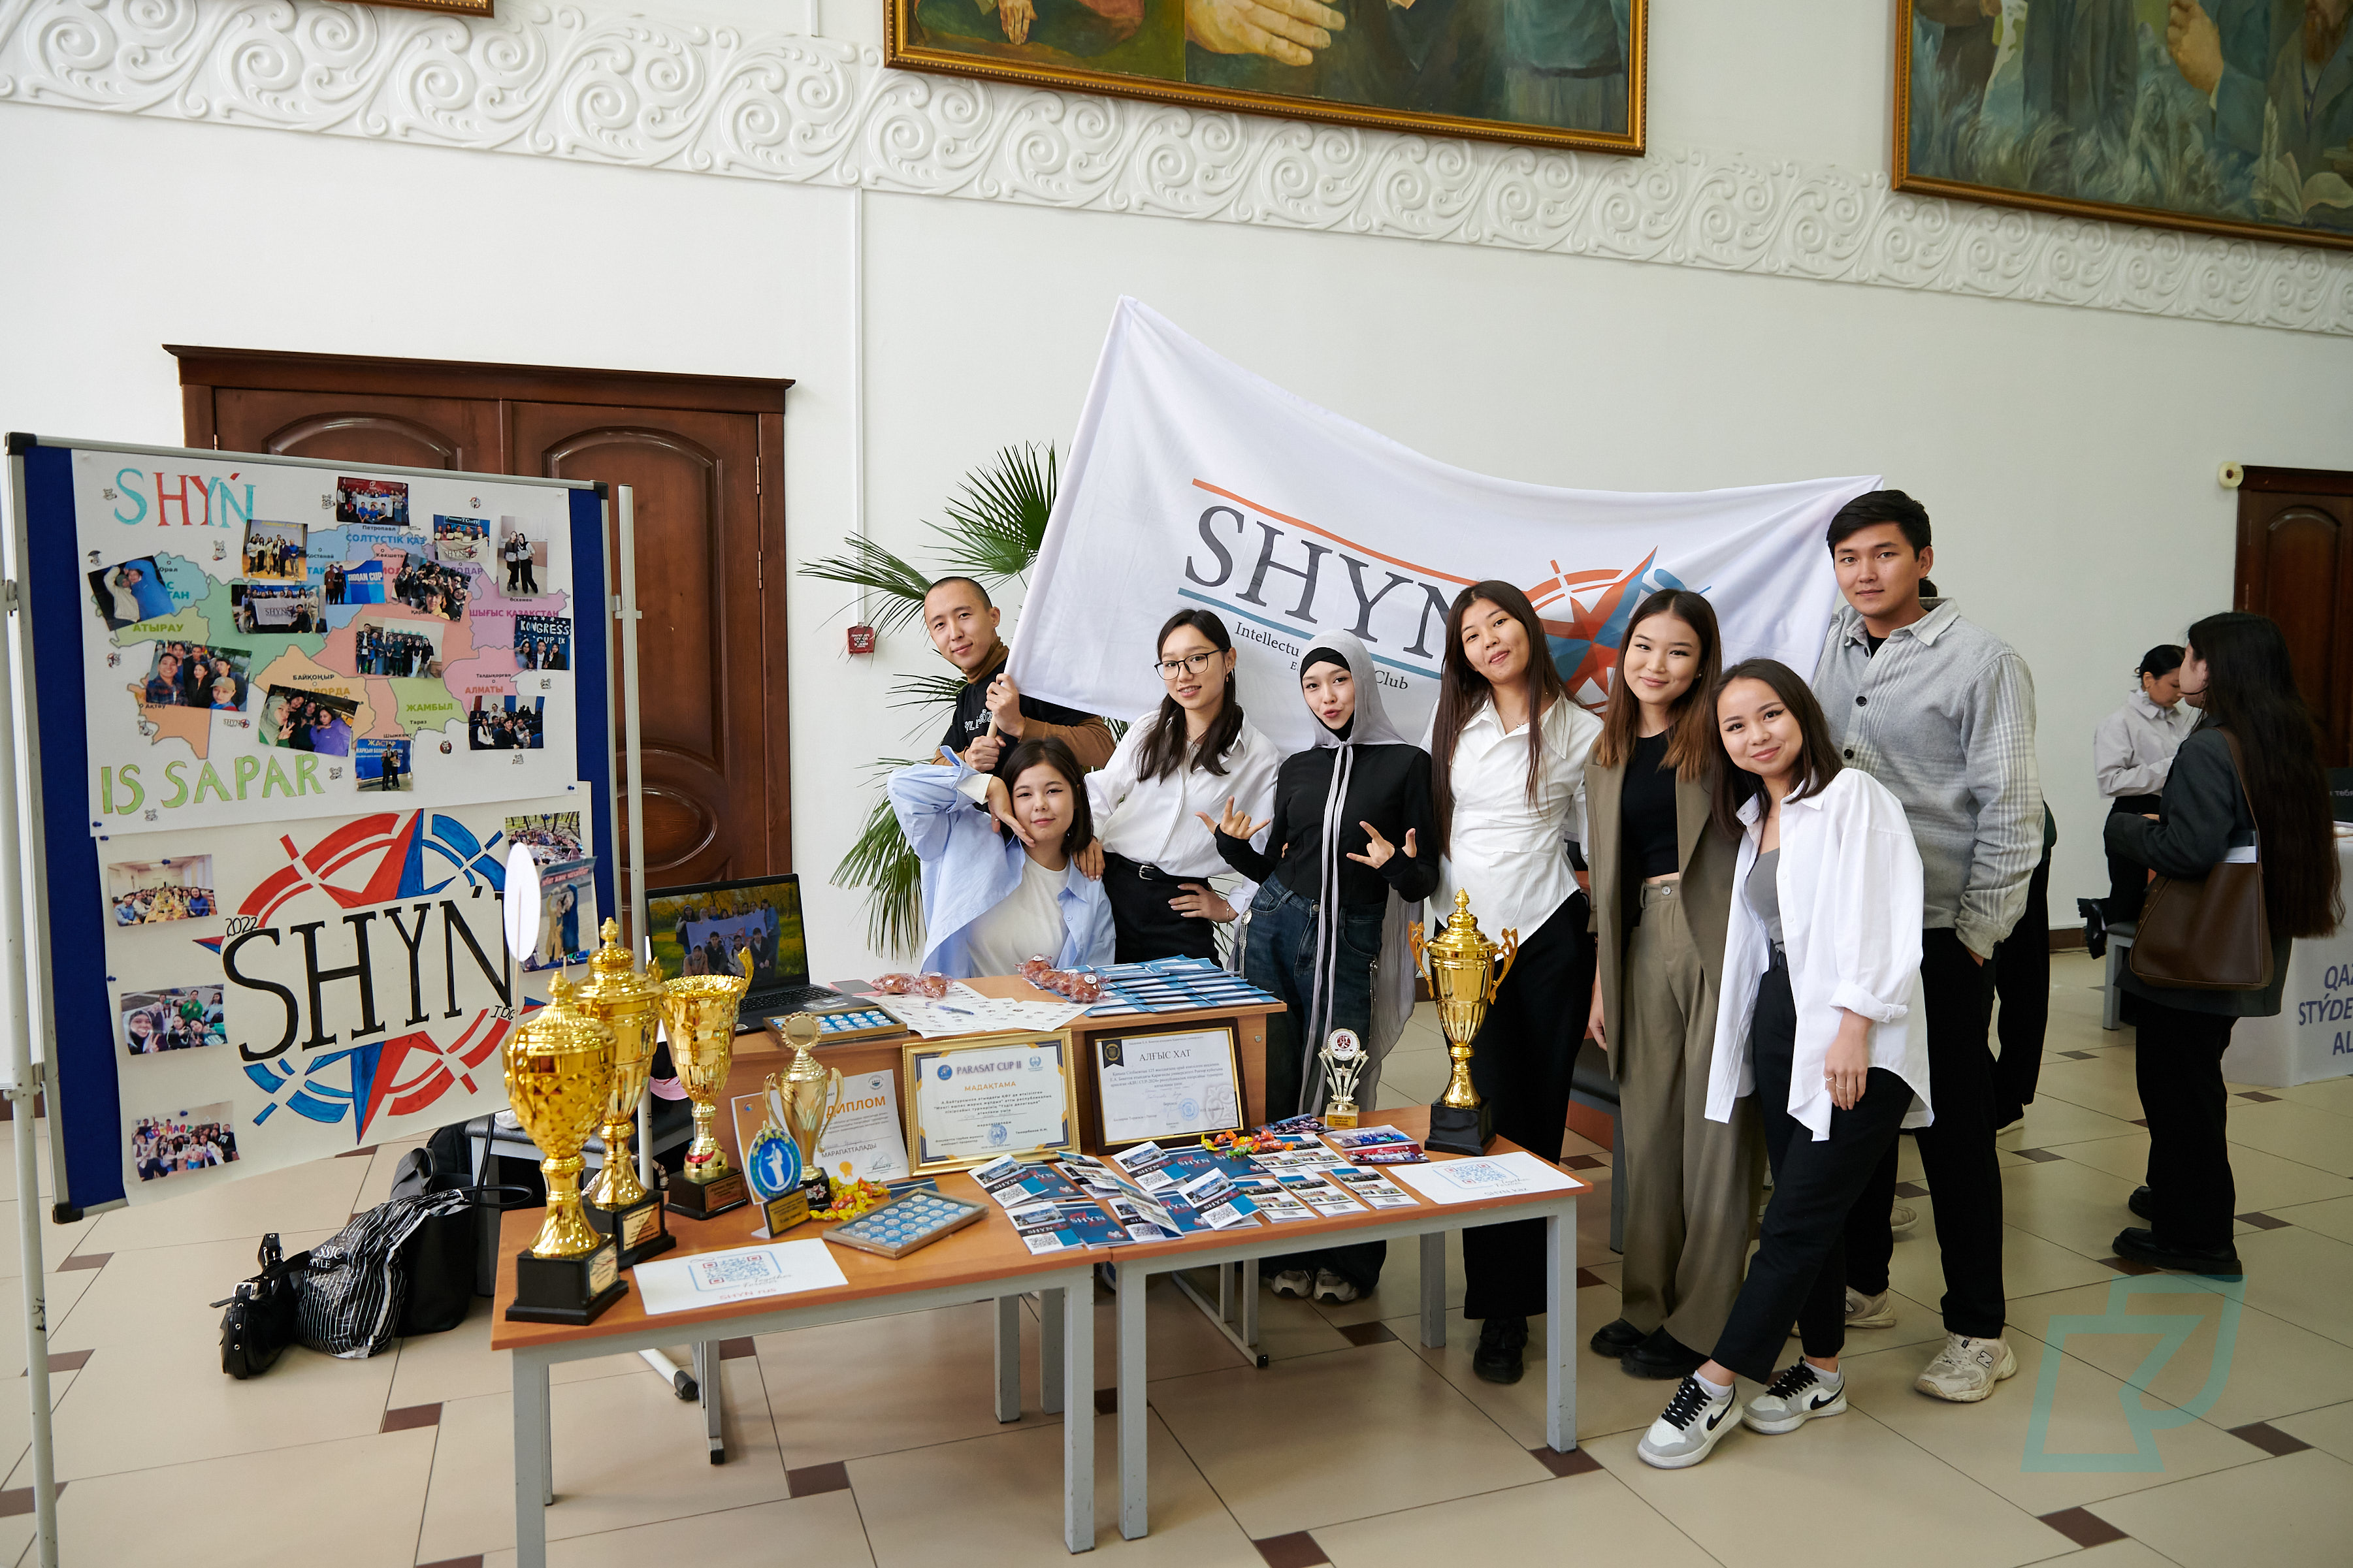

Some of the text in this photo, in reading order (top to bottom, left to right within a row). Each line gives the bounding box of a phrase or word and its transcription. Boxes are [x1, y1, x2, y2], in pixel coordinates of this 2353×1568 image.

[346, 534, 403, 544] СОЛТҮСТІК
[369, 572, 383, 581] CUP
[133, 624, 184, 632] АТЫРАУ
[520, 621, 570, 635] KONGRESS
[406, 703, 453, 712] ЖАМБЫЛ
[101, 753, 325, 815] IS SAPAR
[225, 916, 258, 937] 2022
[1139, 1049, 1192, 1062] АЛҒЫС ХАТ
[957, 1063, 995, 1075] PARASAT
[997, 1061, 1014, 1072] CUP
[1016, 1060, 1022, 1068] II
[964, 1081, 1016, 1092] МАДАҚТАМА
[826, 1096, 886, 1119] ДИПЛОМ
[821, 1143, 877, 1159] МАРАПАТТАЛАДЫ
[1178, 1157, 1210, 1166] SHYN
[1137, 1164, 1160, 1175] SHYN
[993, 1177, 1018, 1190] SHYN
[1204, 1196, 1227, 1210] SHYN
[1069, 1215, 1106, 1224] SHYN
[1027, 1225, 1054, 1234] SHYN
[719, 1290, 754, 1300] SHYN
